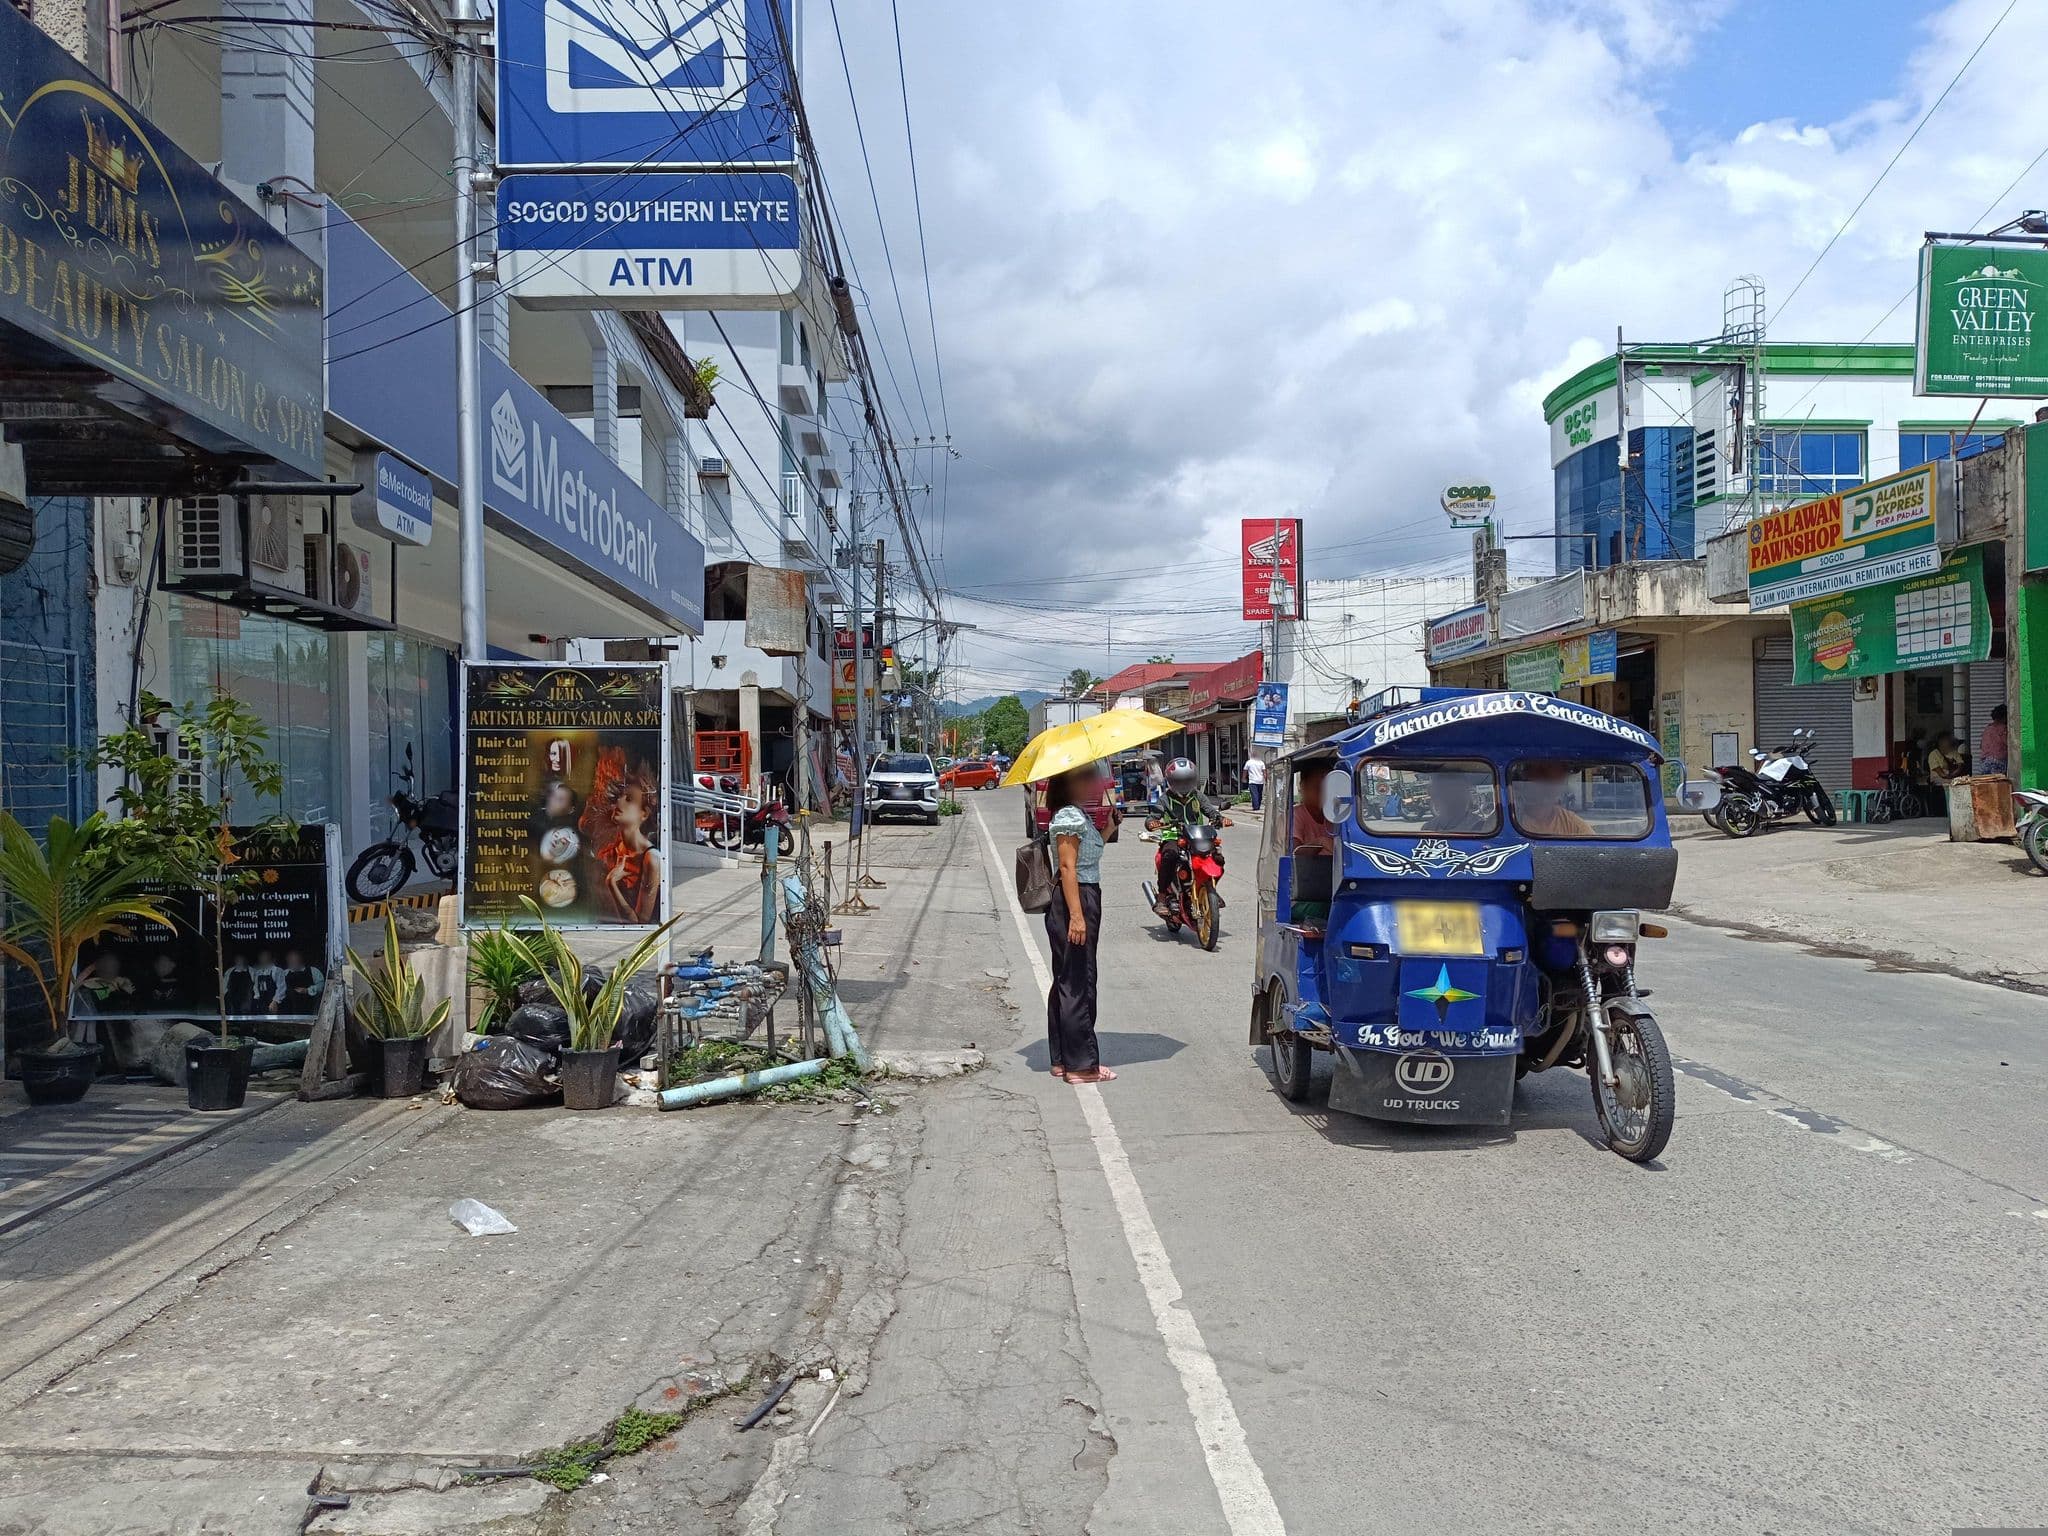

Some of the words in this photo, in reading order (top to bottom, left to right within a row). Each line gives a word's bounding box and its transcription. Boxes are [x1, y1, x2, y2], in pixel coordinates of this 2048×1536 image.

[508, 201, 588, 223] SOGOD
[594, 201, 714, 223] SOUTHERN
[721, 201, 789, 222] LEYTE
[609, 257, 692, 286] ATM
[1958, 287, 2028, 309] GREEN
[1950, 309, 2035, 332] VALLEY
[0, 223, 151, 368] BEAUTY
[157, 323, 248, 420] SALON
[254, 382, 271, 433] &
[277, 400, 316, 460] SPA
[1953, 335, 2031, 346] ENTERPRISES
[1563, 401, 1597, 435] BCCI
[389, 472, 431, 512] Metrobank
[532, 420, 658, 588] Metrobank
[1876, 493, 1924, 518] EXPRESS
[396, 511, 415, 536] ATM
[1763, 496, 1842, 542] PALAWAN
[1875, 515, 1895, 528] PERA
[1896, 507, 1924, 523] PADALA
[1750, 523, 1841, 569] PAWNSHOP
[1819, 552, 1845, 566] SOGOD
[1754, 592, 1775, 607] CLAIM
[1777, 587, 1795, 601] YOUR
[1797, 575, 1854, 597] INTERNATIONAL
[1856, 561, 1906, 583] REMITTANCE
[1909, 554, 1931, 571] HERE
[548, 687, 583, 701] JEMS
[471, 711, 526, 726] ARTISTA
[528, 711, 579, 726] BEAUTY
[581, 711, 620, 726] SALON
[624, 711, 633, 726] &
[637, 710, 660, 725] SPA
[1374, 693, 1525, 746] Immaculate
[1526, 692, 1649, 745] Conception
[477, 737, 504, 748] Hair
[506, 737, 527, 748] Cut
[475, 755, 529, 766] Brazilian
[479, 773, 524, 784] Rebond
[476, 791, 529, 802] Pedicure
[474, 809, 531, 820] Manicure
[477, 827, 502, 838] Foot
[506, 827, 528, 840] Spa
[477, 845, 508, 856] Make
[512, 845, 528, 858] Up
[1416, 838, 1449, 849] NO
[474, 863, 502, 874] Hair
[505, 863, 530, 874] Wax
[472, 880, 499, 892] And
[263, 908, 289, 917] 1500
[221, 920, 258, 929] Medium
[263, 920, 288, 929] 1300
[231, 931, 257, 940] Short
[265, 931, 291, 940] 1000
[1358, 1024, 1382, 1046] In
[1384, 1025, 1426, 1047] God
[1431, 1028, 1467, 1048] We
[1470, 1028, 1519, 1049] Trust
[1400, 1060, 1450, 1082] UD
[1383, 1098, 1404, 1110] UD
[1406, 1099, 1461, 1111] TRUCKS
